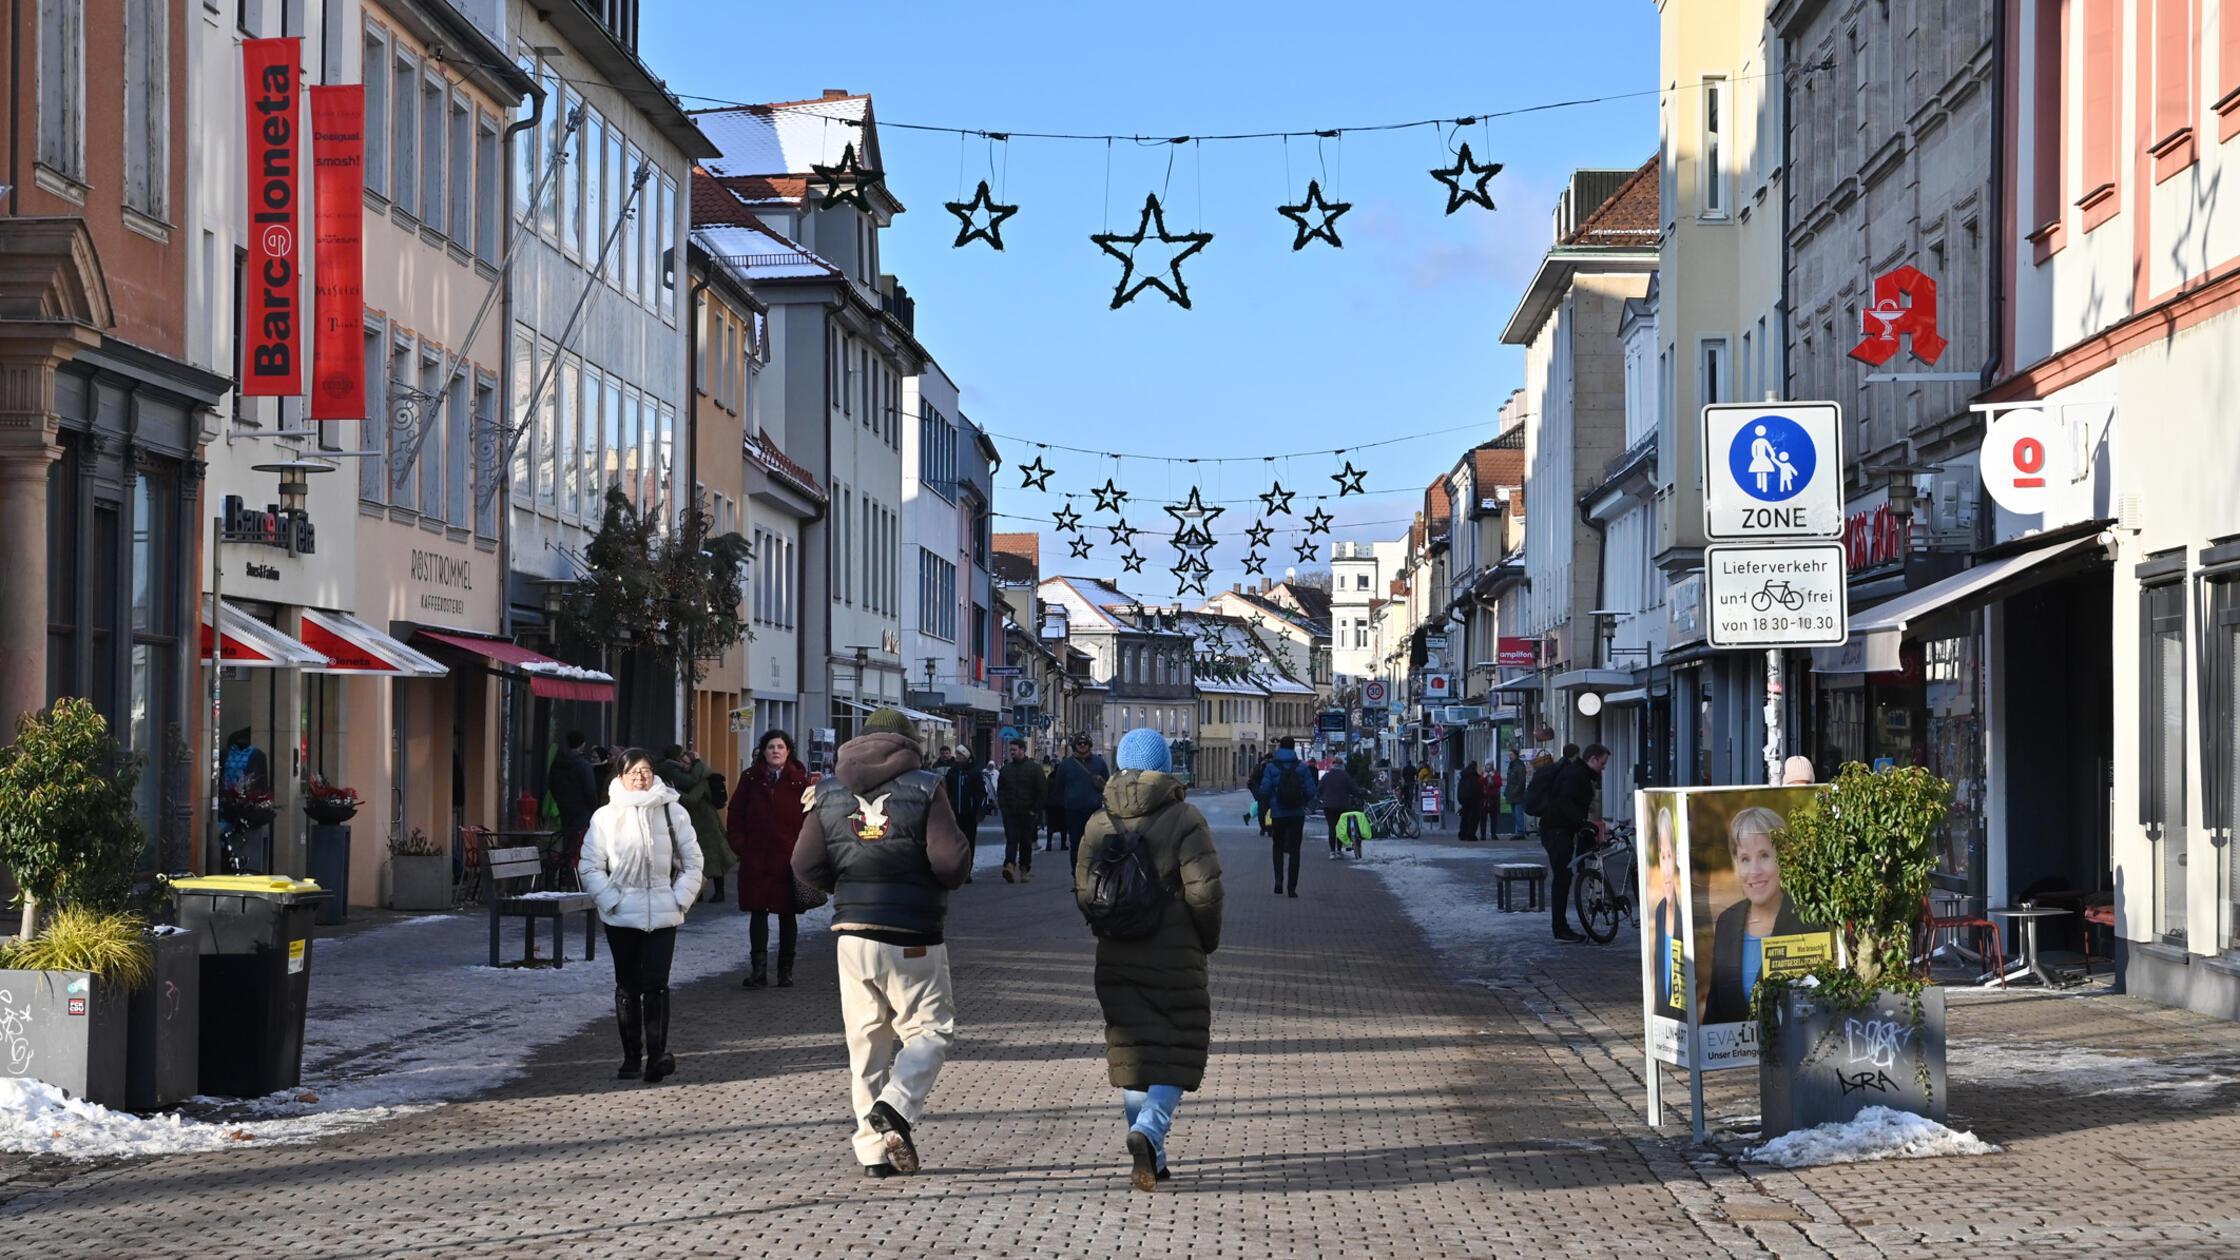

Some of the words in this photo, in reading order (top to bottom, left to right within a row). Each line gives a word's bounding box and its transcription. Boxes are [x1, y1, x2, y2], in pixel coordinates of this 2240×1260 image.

[316, 155, 360, 167] smash!
[254, 64, 291, 377] Barceloneta
[225, 494, 315, 554] Barceloeta
[1741, 507, 1808, 529] ZONE
[1723, 560, 1828, 575] Lieferverkehr
[1807, 589, 1834, 603] frei
[1721, 620, 1748, 632] von
[1499, 650, 1533, 659] amplifon
[1369, 687, 1381, 696] 30
[1708, 1050, 1731, 1060] Unser
